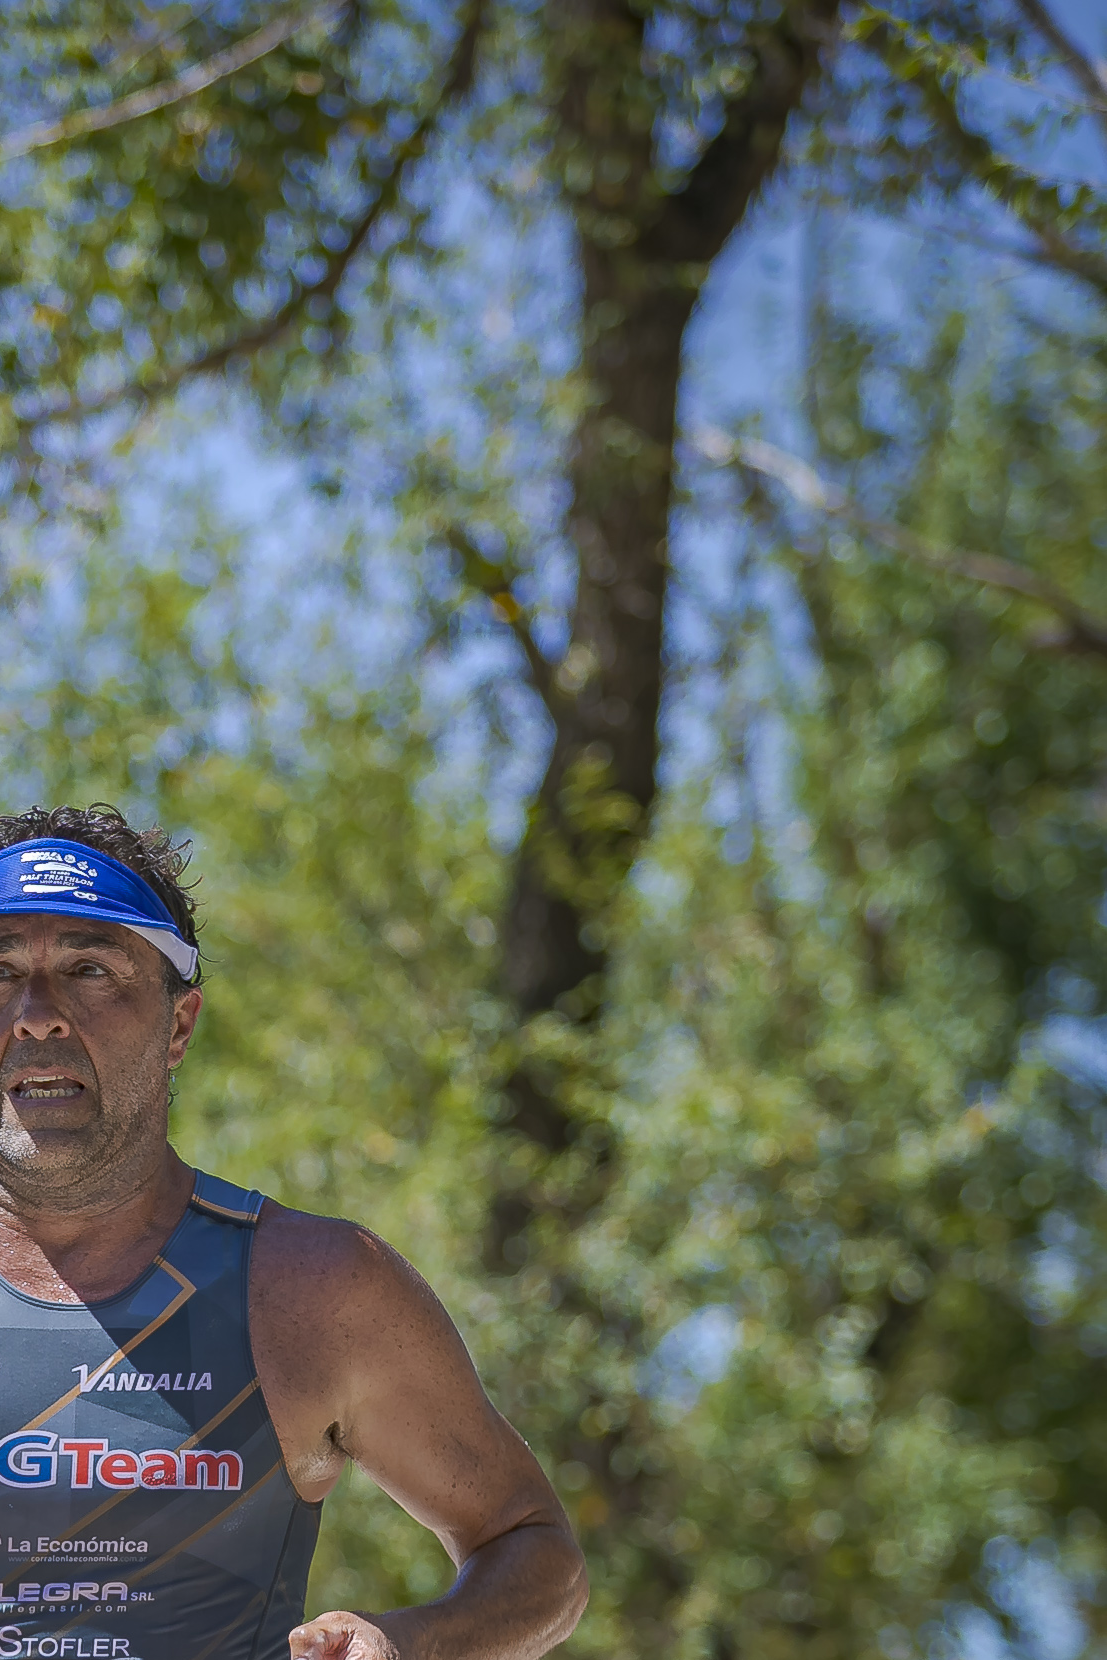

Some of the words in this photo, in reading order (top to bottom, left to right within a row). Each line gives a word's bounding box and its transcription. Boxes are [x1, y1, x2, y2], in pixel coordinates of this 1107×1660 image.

[44, 873, 94, 887] TRIATHLON
[72, 1358, 212, 1393] VANDALIA
[7, 1537, 31, 1553] La
[37, 1536, 149, 1553] Económica
[130, 1592, 155, 1602] SRL
